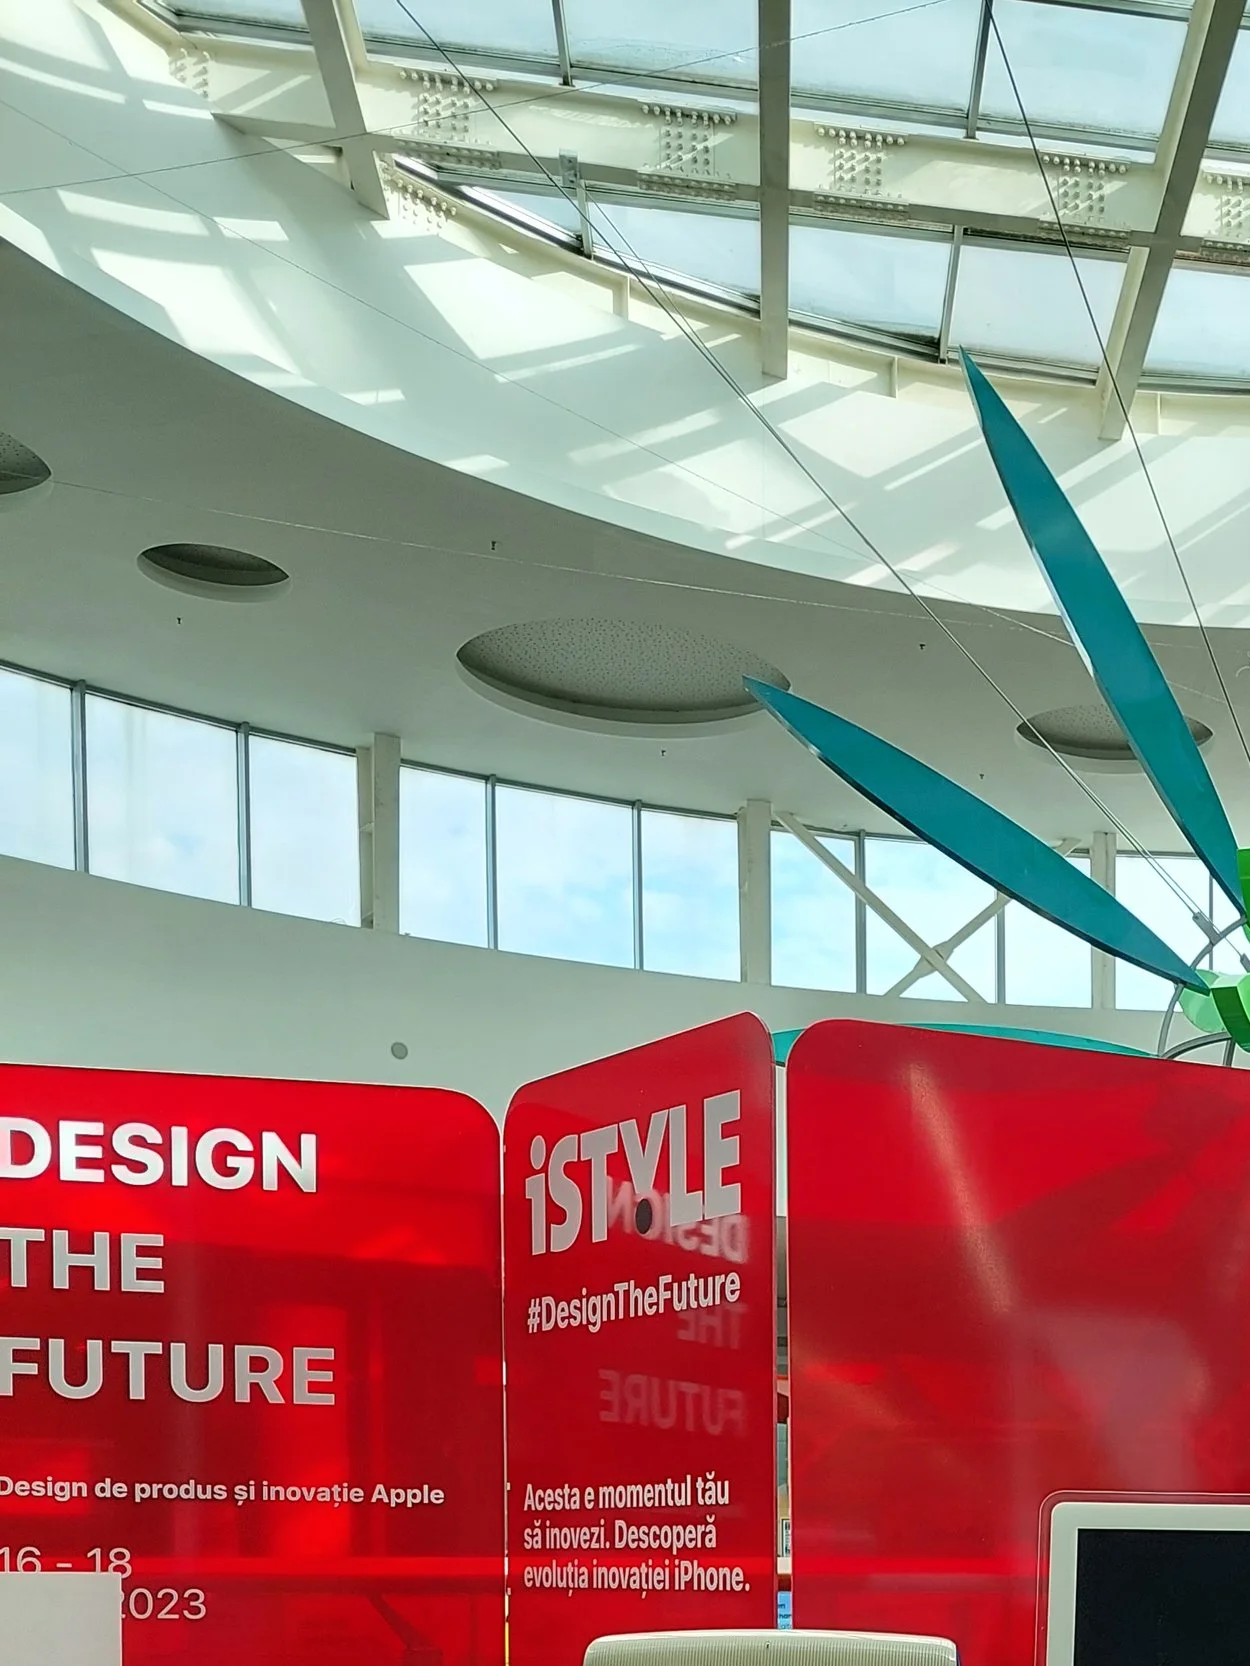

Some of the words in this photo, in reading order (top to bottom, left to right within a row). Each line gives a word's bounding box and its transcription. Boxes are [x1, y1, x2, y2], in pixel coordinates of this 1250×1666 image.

[0, 1116, 318, 1193] DESIGN
[526, 1089, 741, 1255] iSTYLE
[0, 1227, 165, 1293] THE
[527, 1272, 741, 1333] #DesignTheFuture
[0, 1336, 336, 1406] FUTURE
[0, 1476, 88, 1501] Design
[94, 1478, 128, 1498] de
[134, 1479, 228, 1502] produs
[234, 1483, 257, 1507] și
[262, 1483, 364, 1509] inovație
[371, 1485, 445, 1507] Apple
[523, 1483, 580, 1511] Acesta
[584, 1490, 595, 1509] e
[599, 1475, 691, 1509] momentul
[696, 1471, 729, 1505] tău
[524, 1520, 541, 1549] să
[546, 1519, 610, 1549] inovezi.
[615, 1514, 716, 1555] Descoperă
[0, 1546, 42, 1573] 16
[87, 1548, 132, 1579] 18
[524, 1559, 588, 1597] evoluția
[592, 1558, 669, 1599] inovației
[674, 1560, 750, 1591] iPhone.
[121, 1588, 206, 1620] 023
